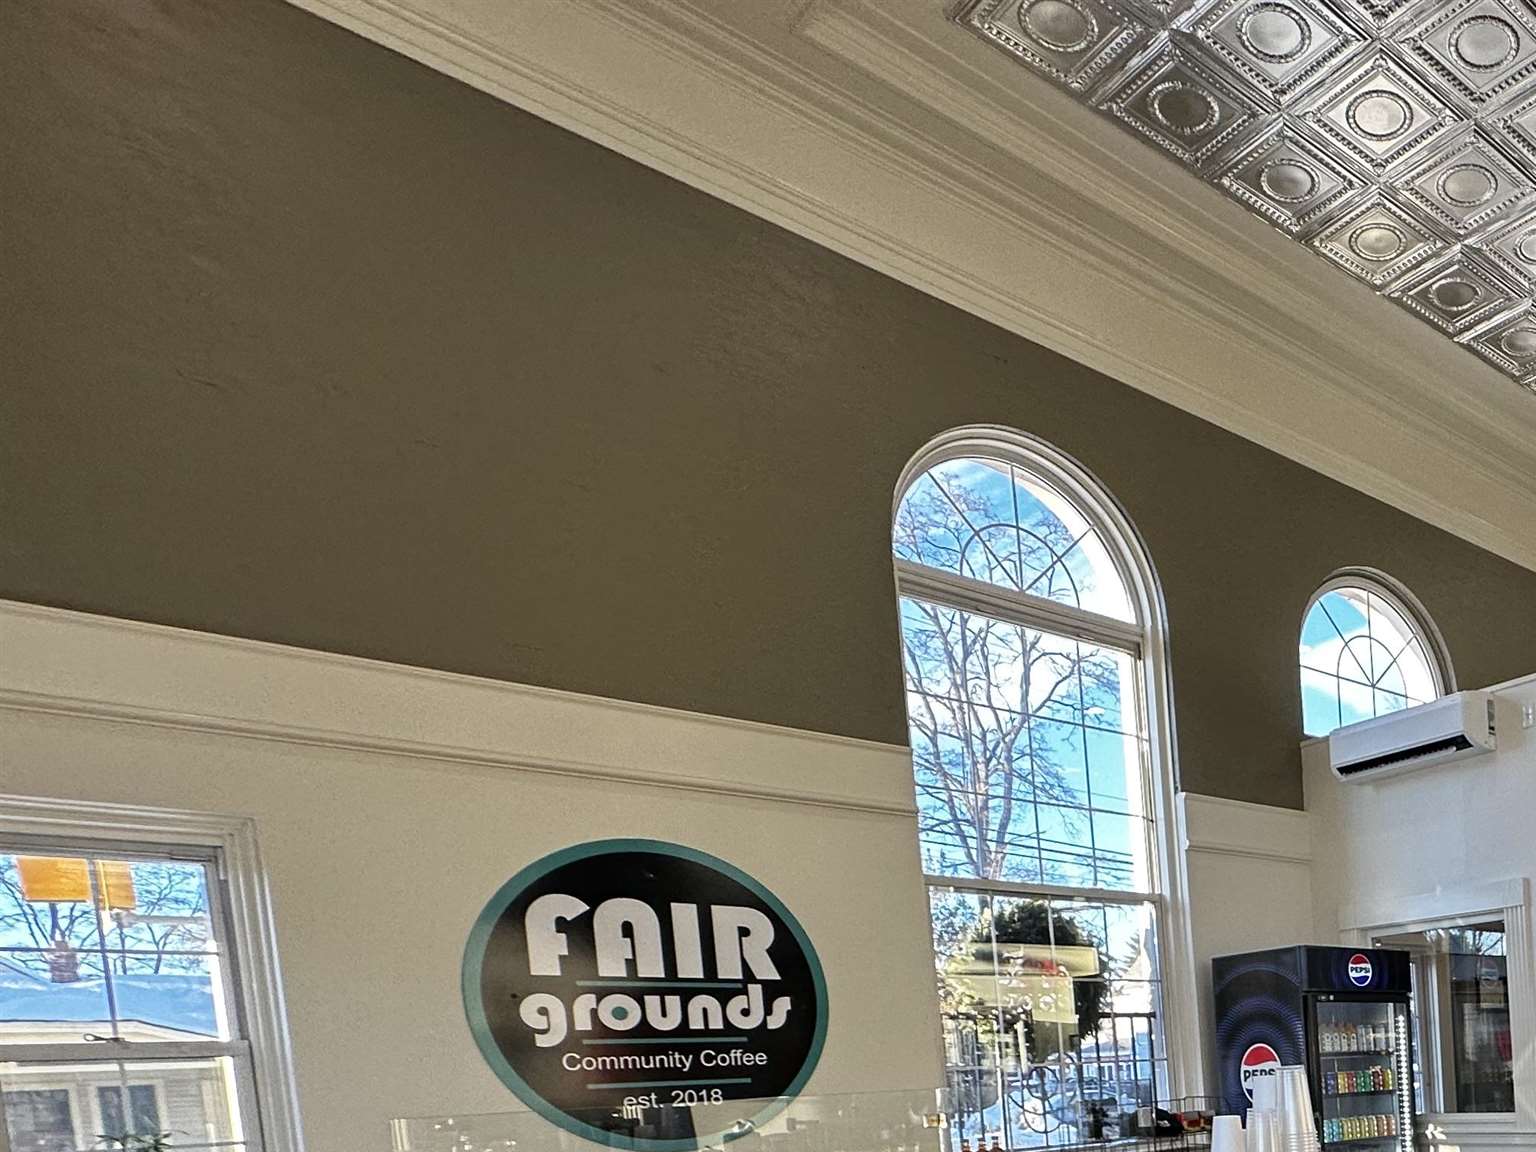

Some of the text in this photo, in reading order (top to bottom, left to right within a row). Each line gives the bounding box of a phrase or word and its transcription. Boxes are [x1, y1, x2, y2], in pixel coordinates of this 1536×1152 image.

[524, 893, 782, 981] FAIR
[1350, 966, 1370, 974] PEPSI
[519, 983, 792, 1048] grounds
[562, 1049, 768, 1072] Community Coffee
[623, 1088, 723, 1109] est. 2018
